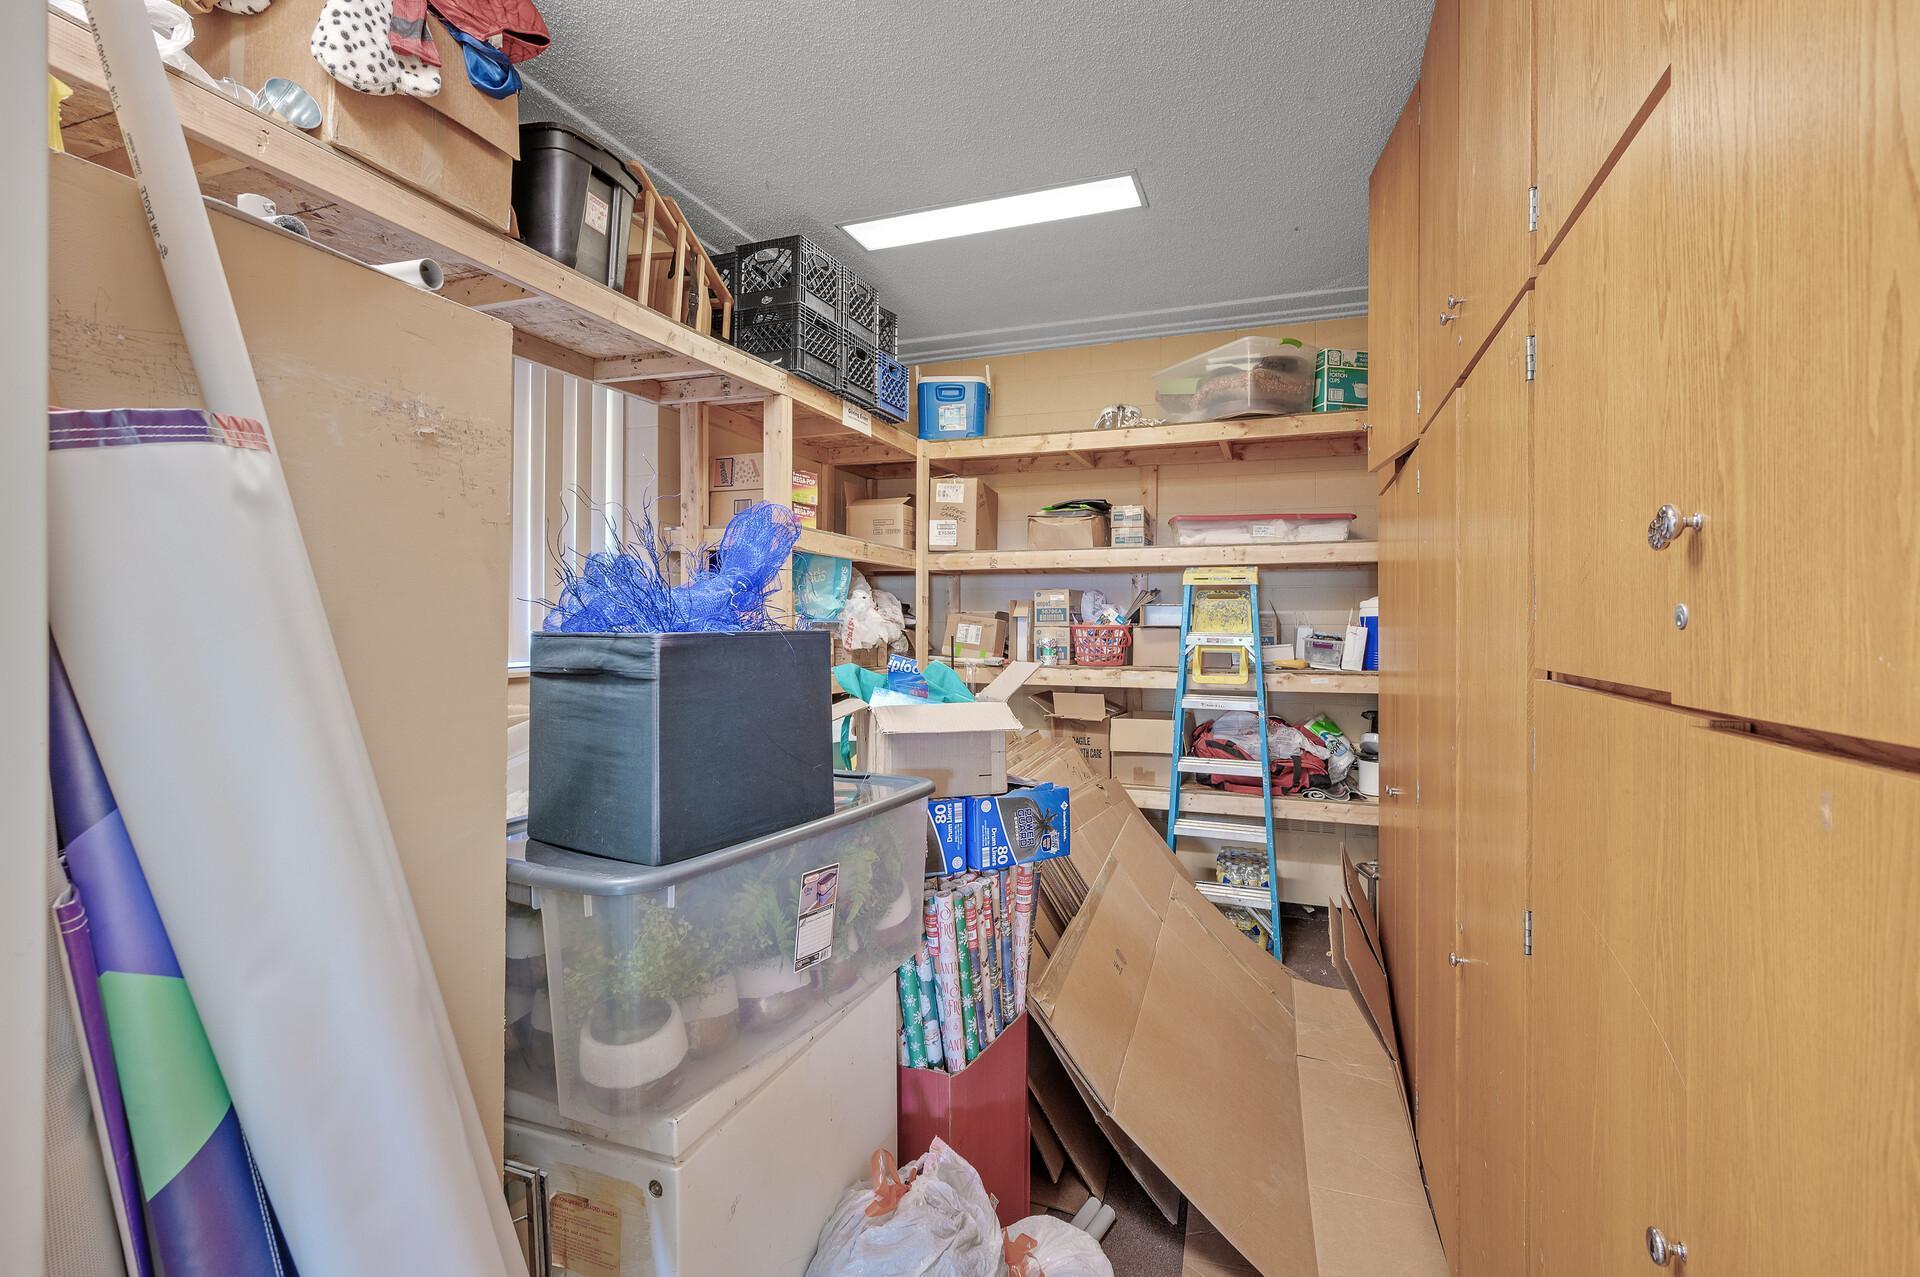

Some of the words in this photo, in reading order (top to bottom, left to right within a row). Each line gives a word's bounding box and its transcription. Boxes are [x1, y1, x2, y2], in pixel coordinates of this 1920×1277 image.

[141, 185, 155, 222] EAGLE
[151, 223, 161, 238] JM
[888, 655, 920, 675] iploc
[1072, 736, 1091, 746] AGILE
[1090, 748, 1103, 759] CARE
[934, 803, 947, 824] 80
[1017, 809, 1028, 848] GUARD
[1025, 808, 1035, 847] POWER
[997, 845, 1008, 865] 80
